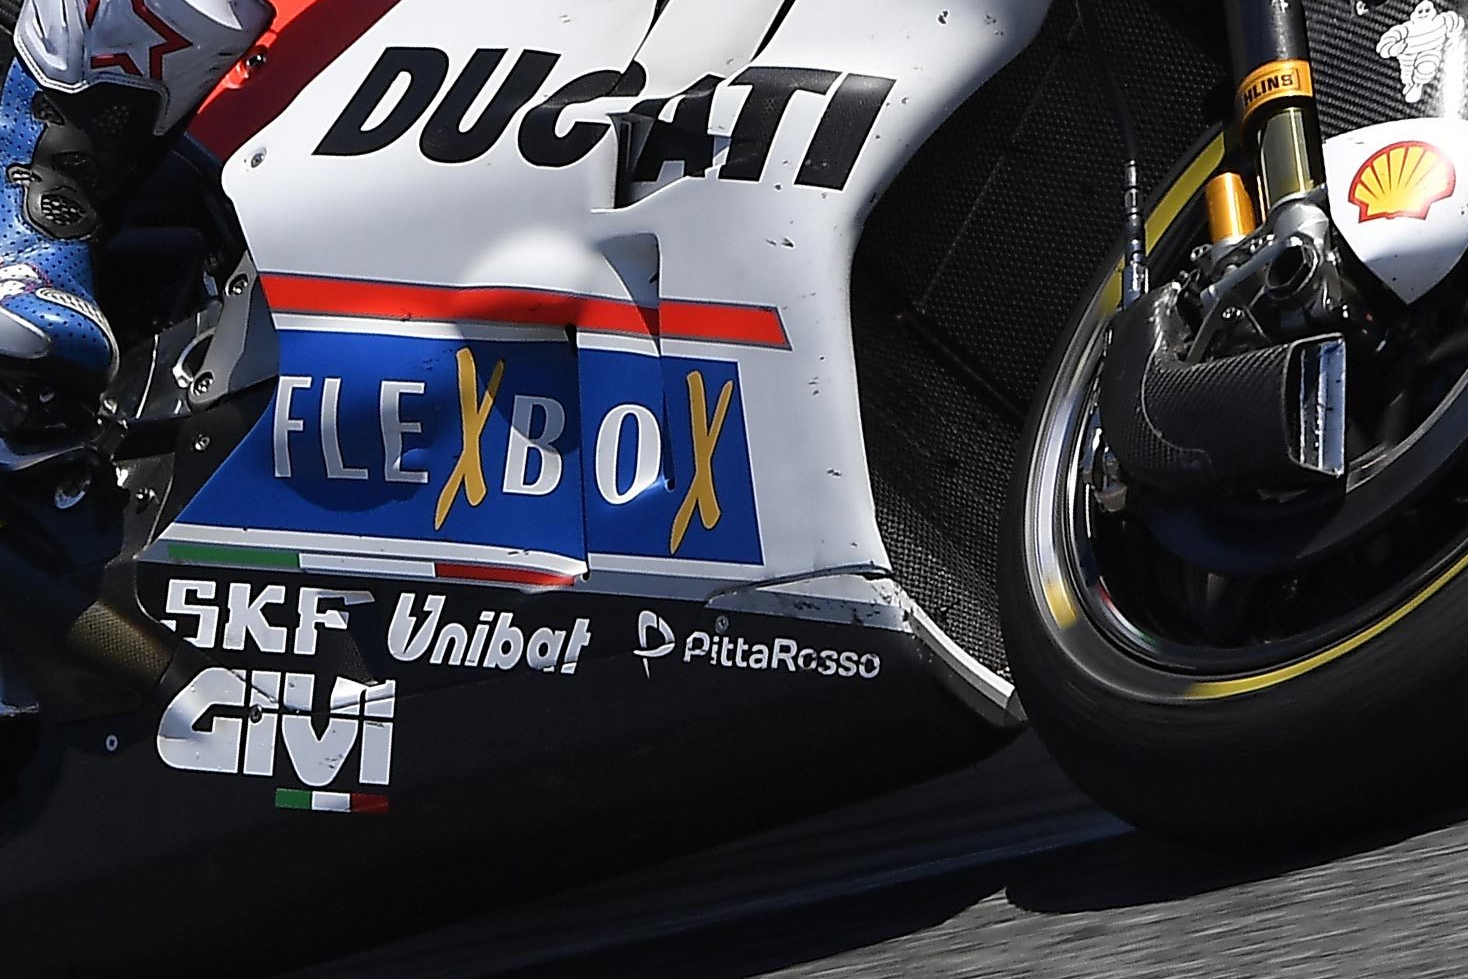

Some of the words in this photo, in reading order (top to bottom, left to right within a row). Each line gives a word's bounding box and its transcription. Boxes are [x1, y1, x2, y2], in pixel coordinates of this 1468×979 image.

[310, 45, 898, 192] DUCATI
[1243, 73, 1294, 107] HLINS
[272, 345, 734, 555] FLEXBOX
[159, 578, 376, 656] SKF
[387, 592, 592, 675] Unibat
[683, 630, 882, 680] PittaRosso
[156, 666, 397, 788] GIVI
